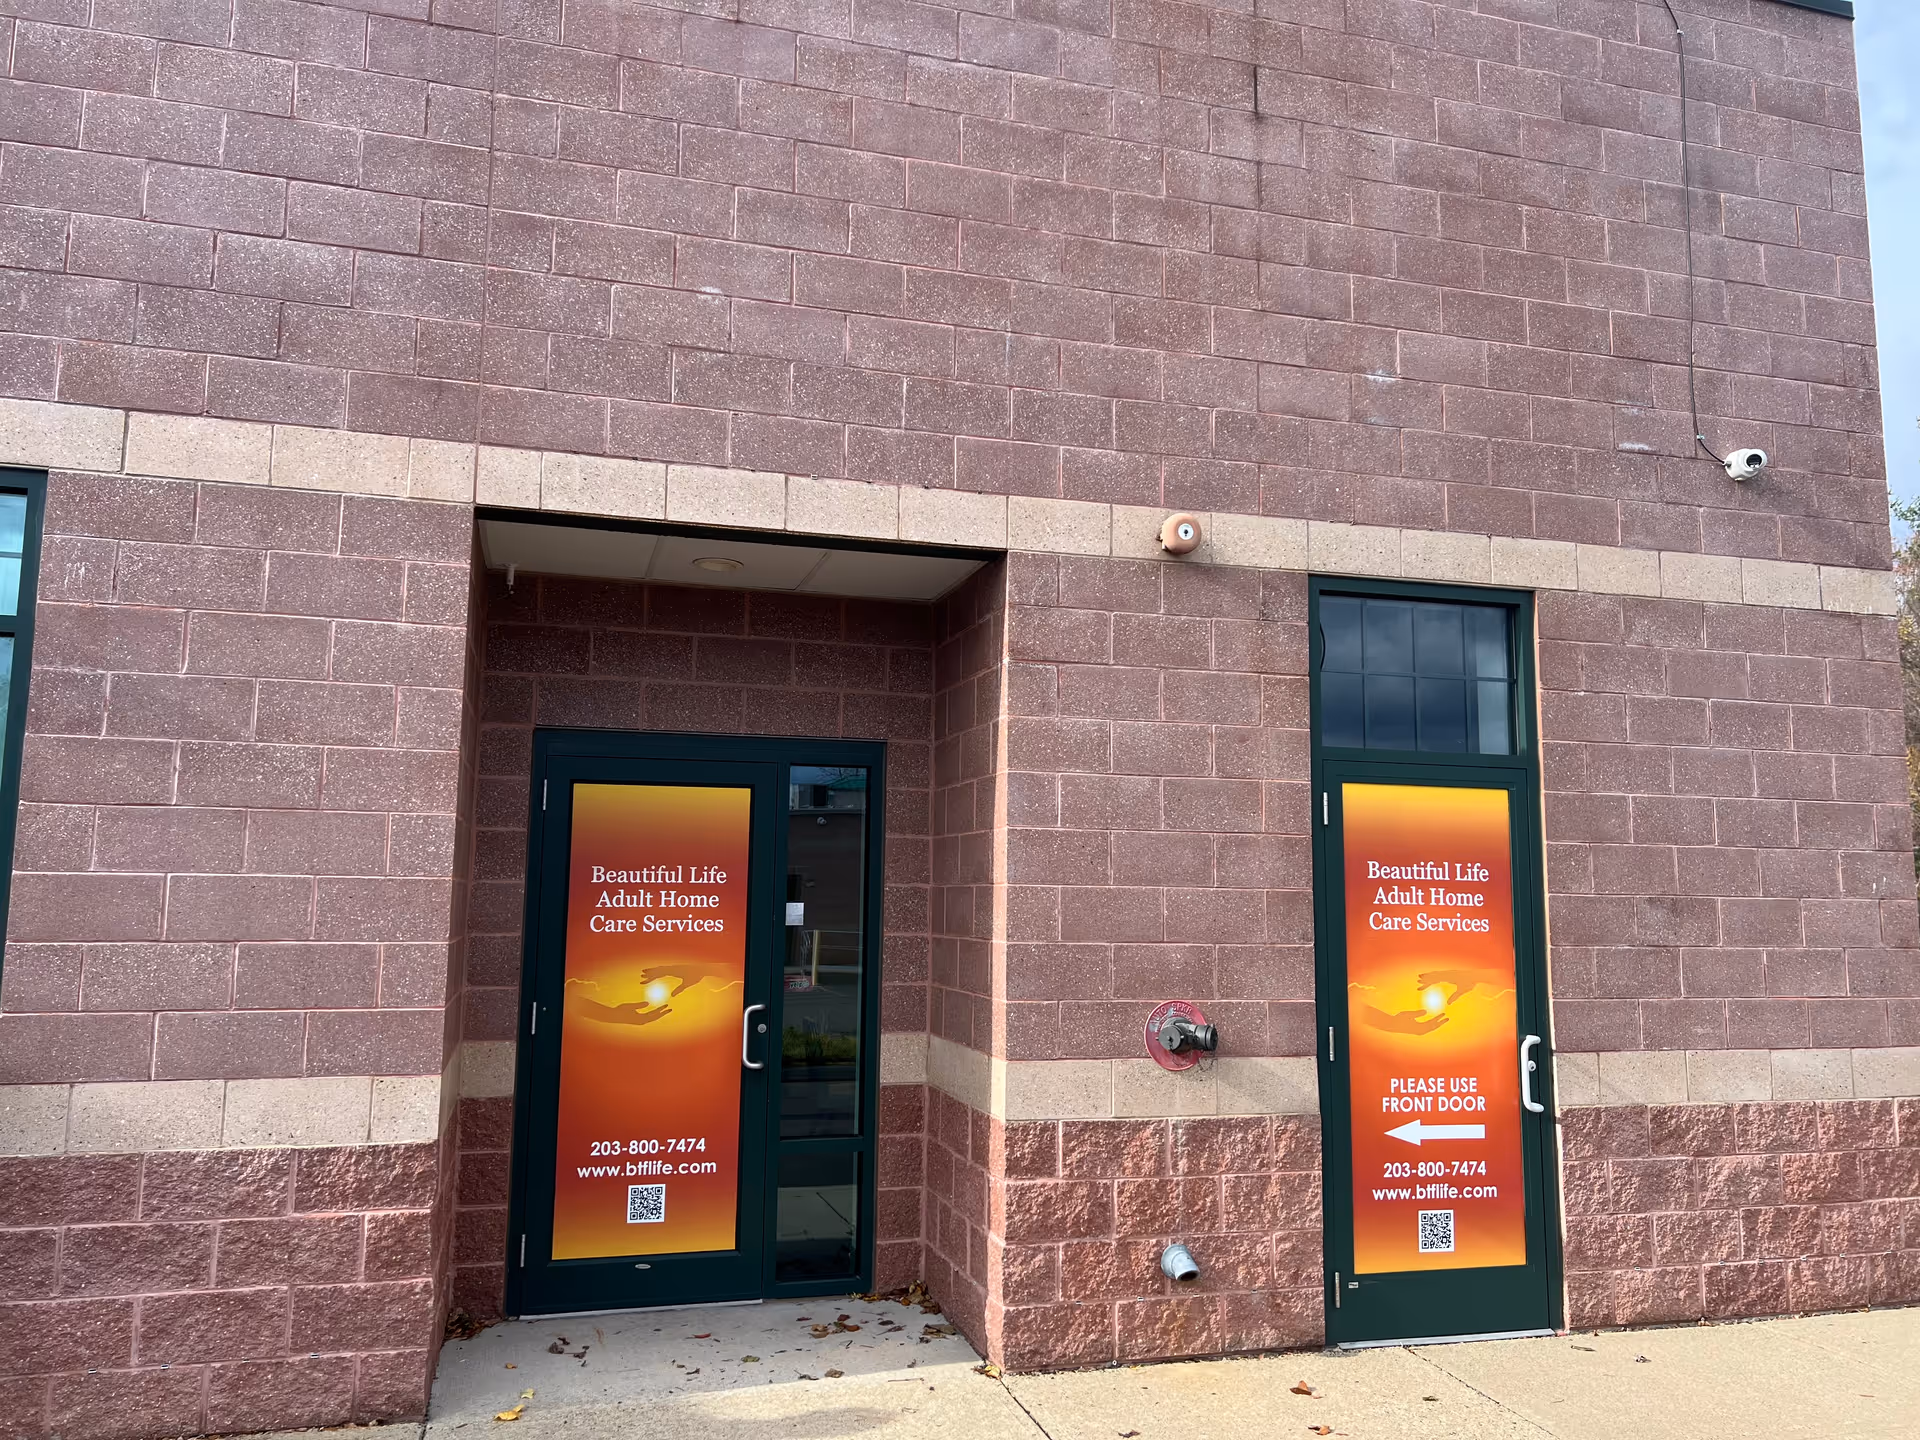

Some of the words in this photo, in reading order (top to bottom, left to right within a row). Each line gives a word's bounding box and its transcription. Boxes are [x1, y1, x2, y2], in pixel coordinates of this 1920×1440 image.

[591, 866, 682, 883] Beautiful
[690, 866, 726, 883] Life
[1367, 861, 1450, 880] Beautiful
[1455, 863, 1489, 881] Life
[596, 889, 653, 907] Adult
[659, 891, 719, 907] Home
[1373, 886, 1425, 905] Adult
[1430, 888, 1483, 906] Home
[590, 915, 636, 932] Care
[643, 914, 723, 932] Services
[1369, 912, 1411, 930] Care
[1417, 913, 1489, 932] Services
[1391, 1078, 1445, 1093] PLEASE
[1451, 1077, 1477, 1093] USE
[1383, 1097, 1433, 1112] FRONT
[1439, 1096, 1485, 1111] DOOR
[591, 1138, 705, 1155] 203-800-7474
[1384, 1161, 1486, 1177] 203-800-7474
